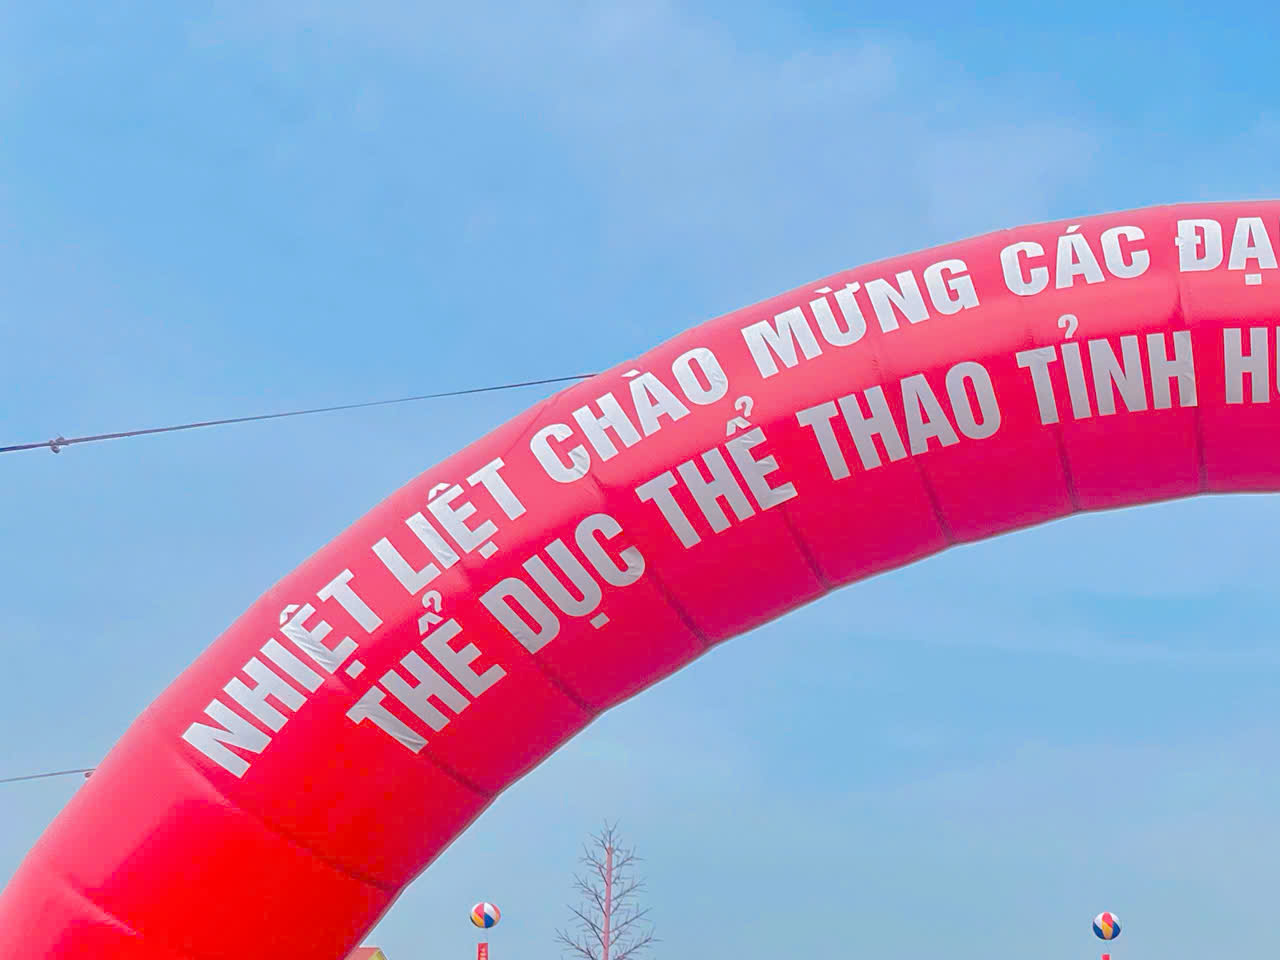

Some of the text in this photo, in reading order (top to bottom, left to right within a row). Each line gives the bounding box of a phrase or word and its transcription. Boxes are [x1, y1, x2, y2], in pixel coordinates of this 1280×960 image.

[181, 568, 382, 777] NHIỆT
[372, 457, 526, 595] LIỆT
[530, 347, 728, 482] CHÀO
[741, 259, 979, 378] MỪNG
[1000, 224, 1149, 295] CÁC
[347, 591, 505, 752] THỂ
[479, 514, 644, 653] DỤC
[636, 396, 797, 547] THỂ
[796, 362, 1000, 480] THAO
[1016, 314, 1197, 424] TỈNH
